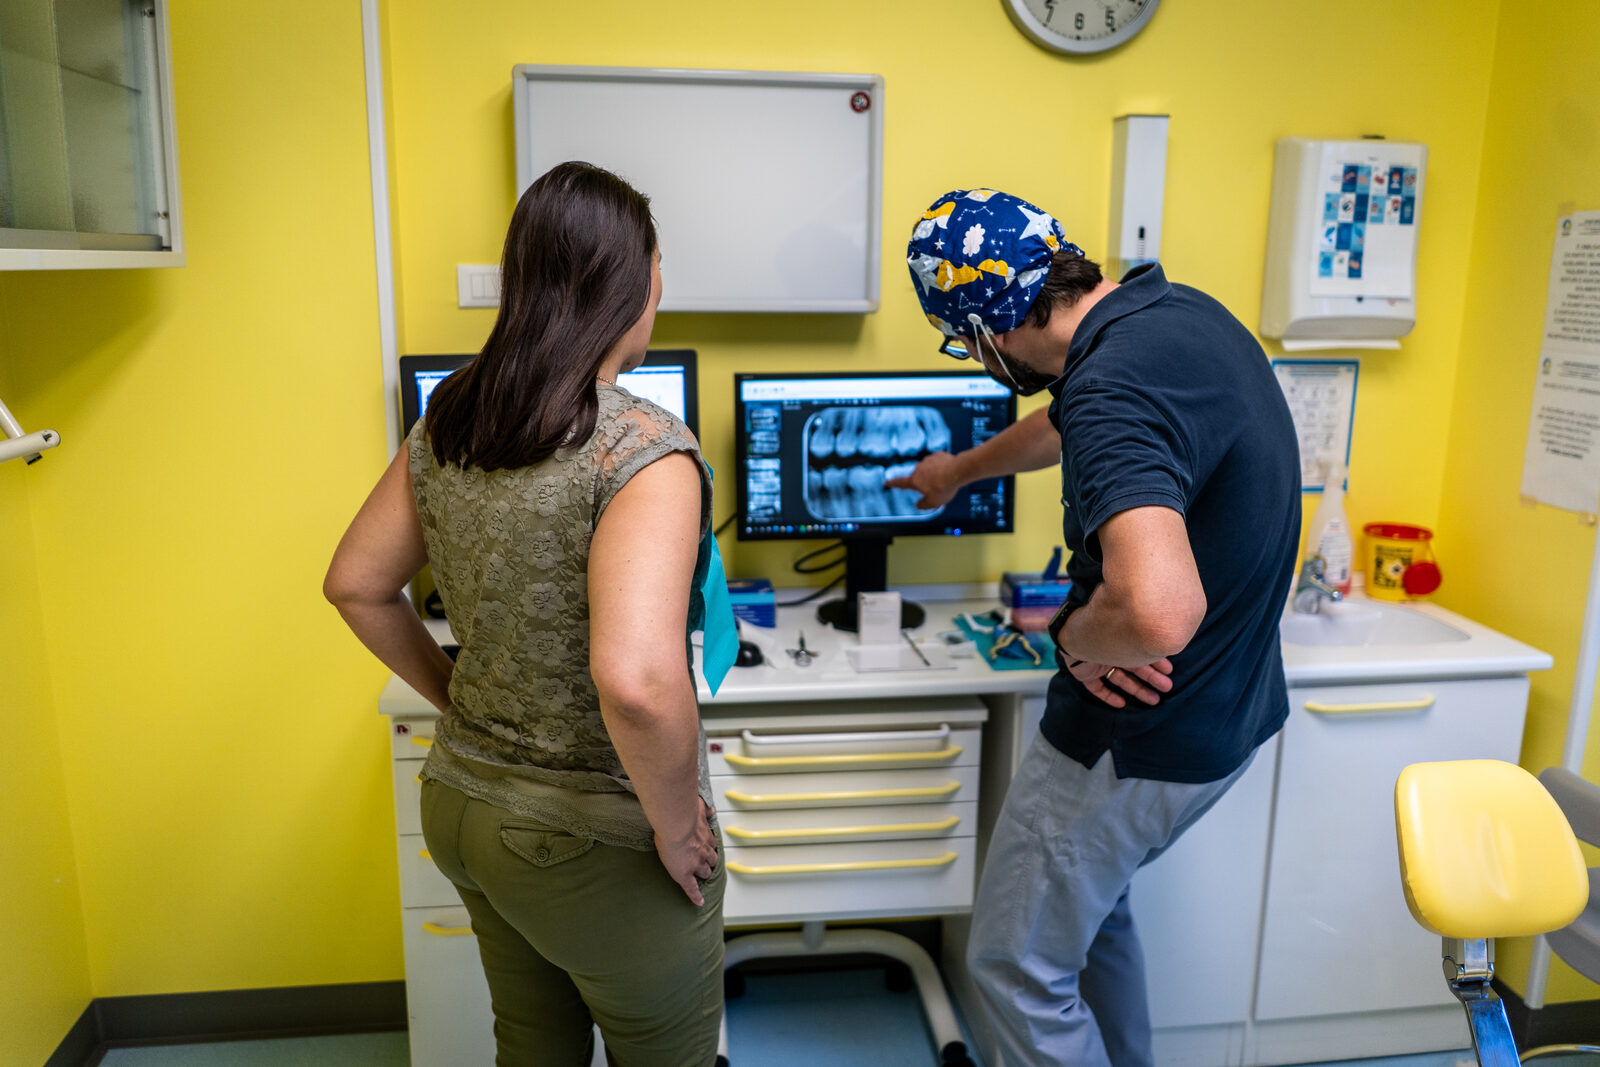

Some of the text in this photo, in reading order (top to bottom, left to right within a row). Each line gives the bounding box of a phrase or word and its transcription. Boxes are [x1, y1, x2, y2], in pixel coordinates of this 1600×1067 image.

[1045, 5, 1054, 24] 7
[1075, 12, 1084, 30] 6
[1105, 10, 1114, 27] 5
